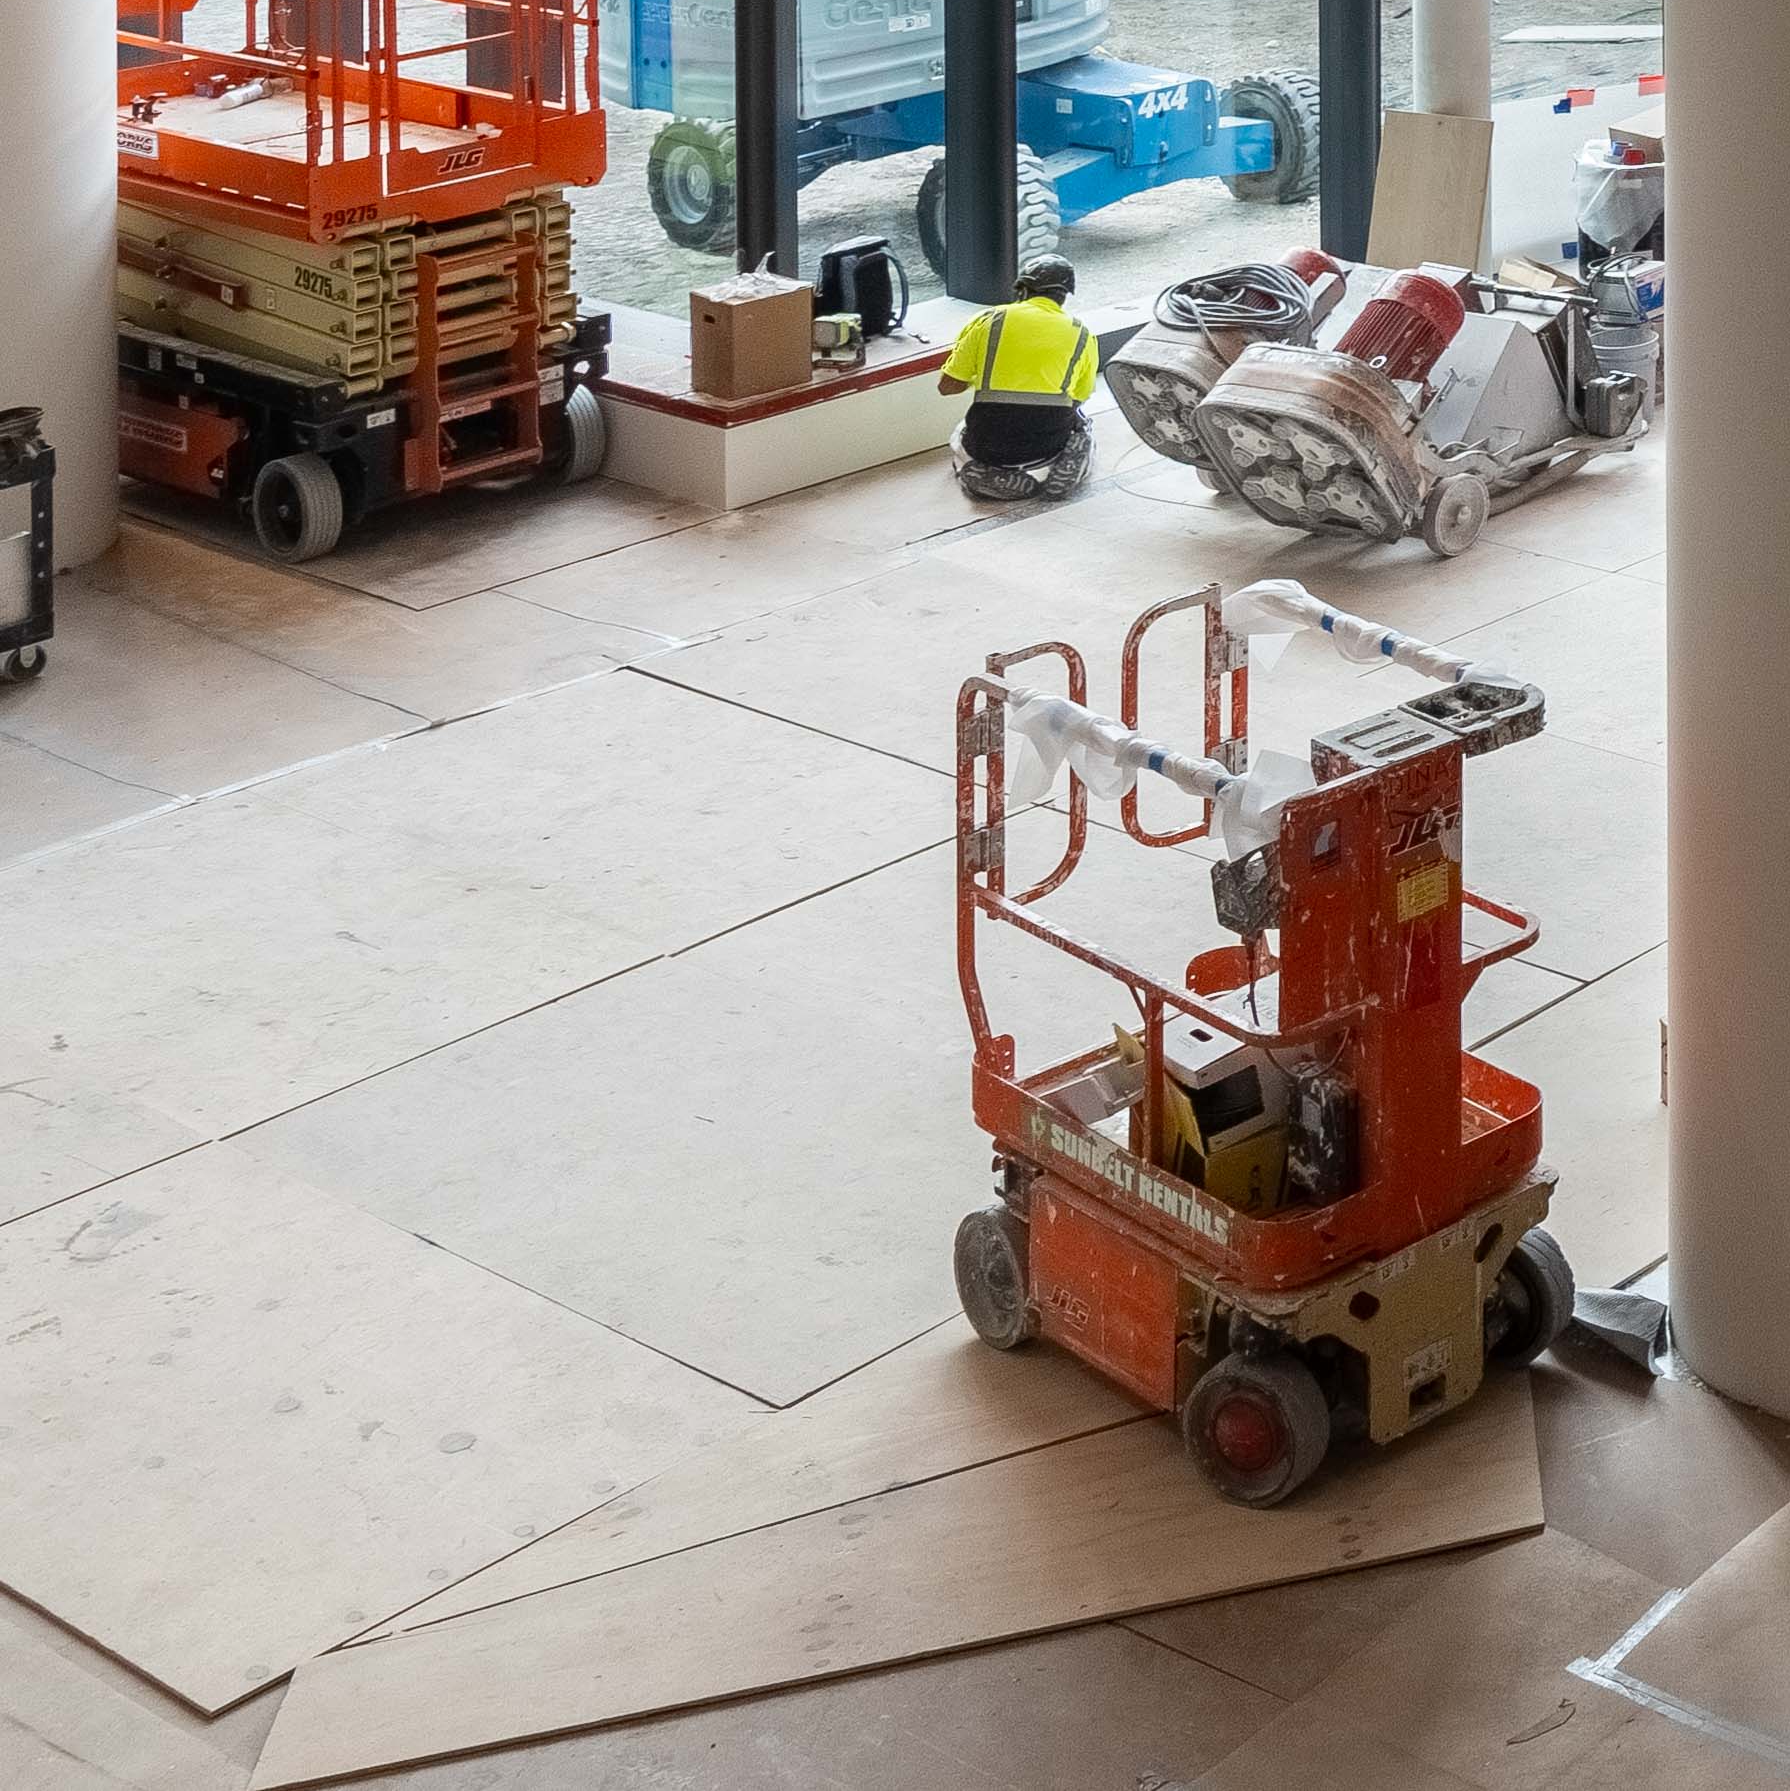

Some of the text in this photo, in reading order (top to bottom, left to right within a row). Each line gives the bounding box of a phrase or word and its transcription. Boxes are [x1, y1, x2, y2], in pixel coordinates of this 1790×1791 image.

[1138, 84, 1188, 119] 4x4
[437, 147, 485, 176] JLG
[322, 203, 378, 229] 29275
[294, 265, 333, 298] 29275
[1050, 1123, 1229, 1247] SUNBELT RENTALS
